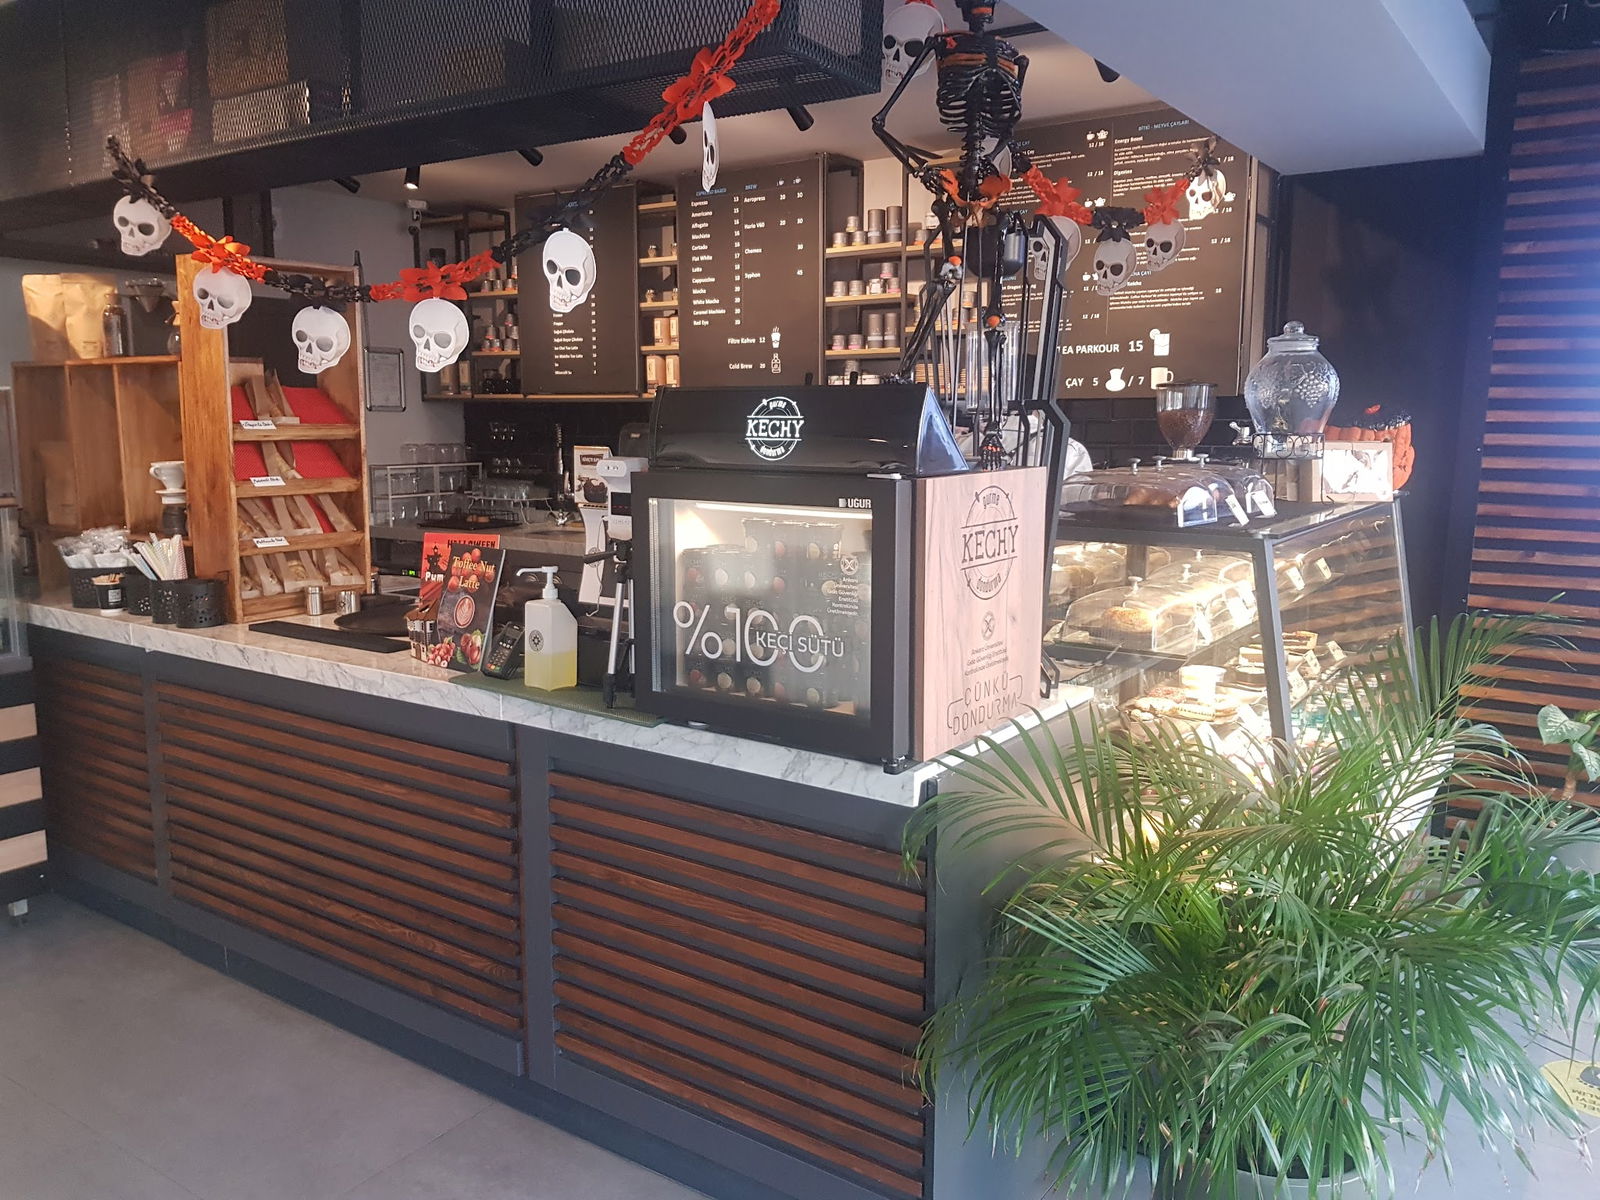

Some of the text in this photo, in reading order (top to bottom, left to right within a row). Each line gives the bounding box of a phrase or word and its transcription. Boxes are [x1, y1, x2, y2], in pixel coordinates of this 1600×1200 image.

[1076, 344, 1120, 354] PARKOUR
[1128, 340, 1144, 352] 15
[1066, 378, 1084, 388] ÇAY
[1092, 378, 1098, 386] 5
[1138, 376, 1144, 386] 7
[746, 420, 804, 438] KECHY
[962, 525, 1018, 564] KECHY
[452, 556, 496, 573] Toffee Nut
[458, 576, 480, 590] Latte
[673, 601, 824, 672] %100
[756, 630, 844, 658] KEÇİ SÜTÜ
[952, 692, 1018, 735] DONDURMA
